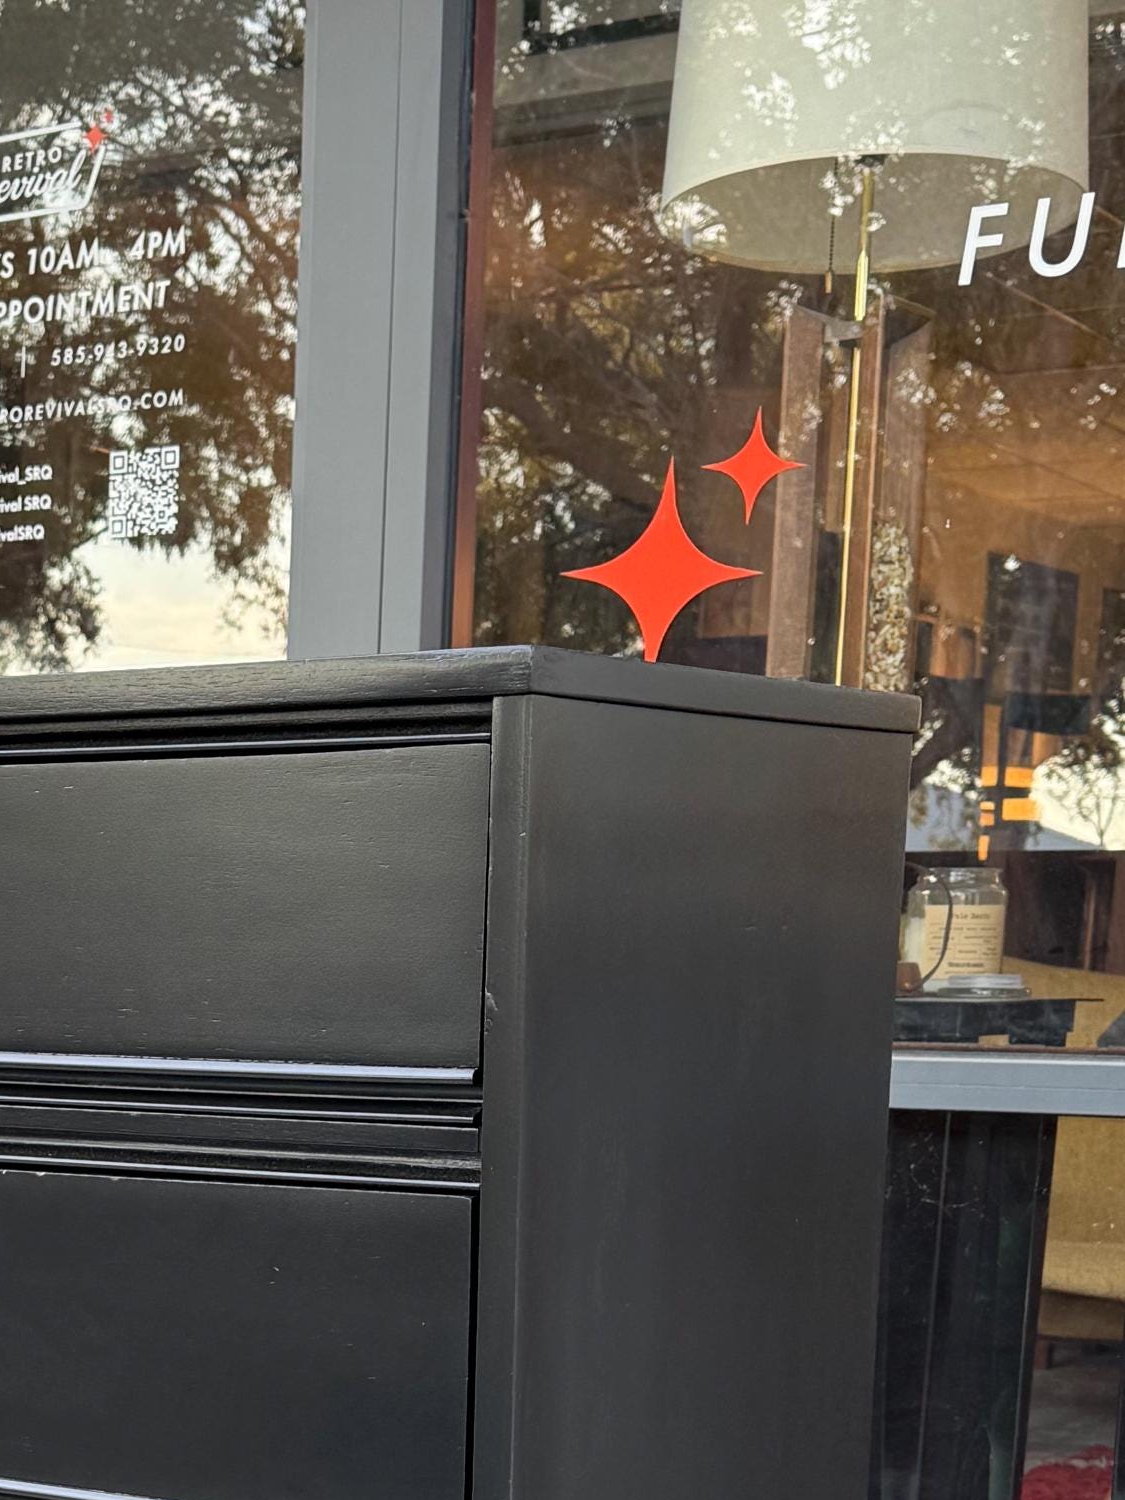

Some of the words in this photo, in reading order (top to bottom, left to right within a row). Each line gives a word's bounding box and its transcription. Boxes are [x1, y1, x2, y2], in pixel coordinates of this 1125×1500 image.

[1, 146, 62, 173] RETRO
[27, 237, 100, 275] 10AM
[131, 225, 186, 260] 4PM
[958, 192, 1125, 286] FU
[24, 494, 51, 511] SRQ
